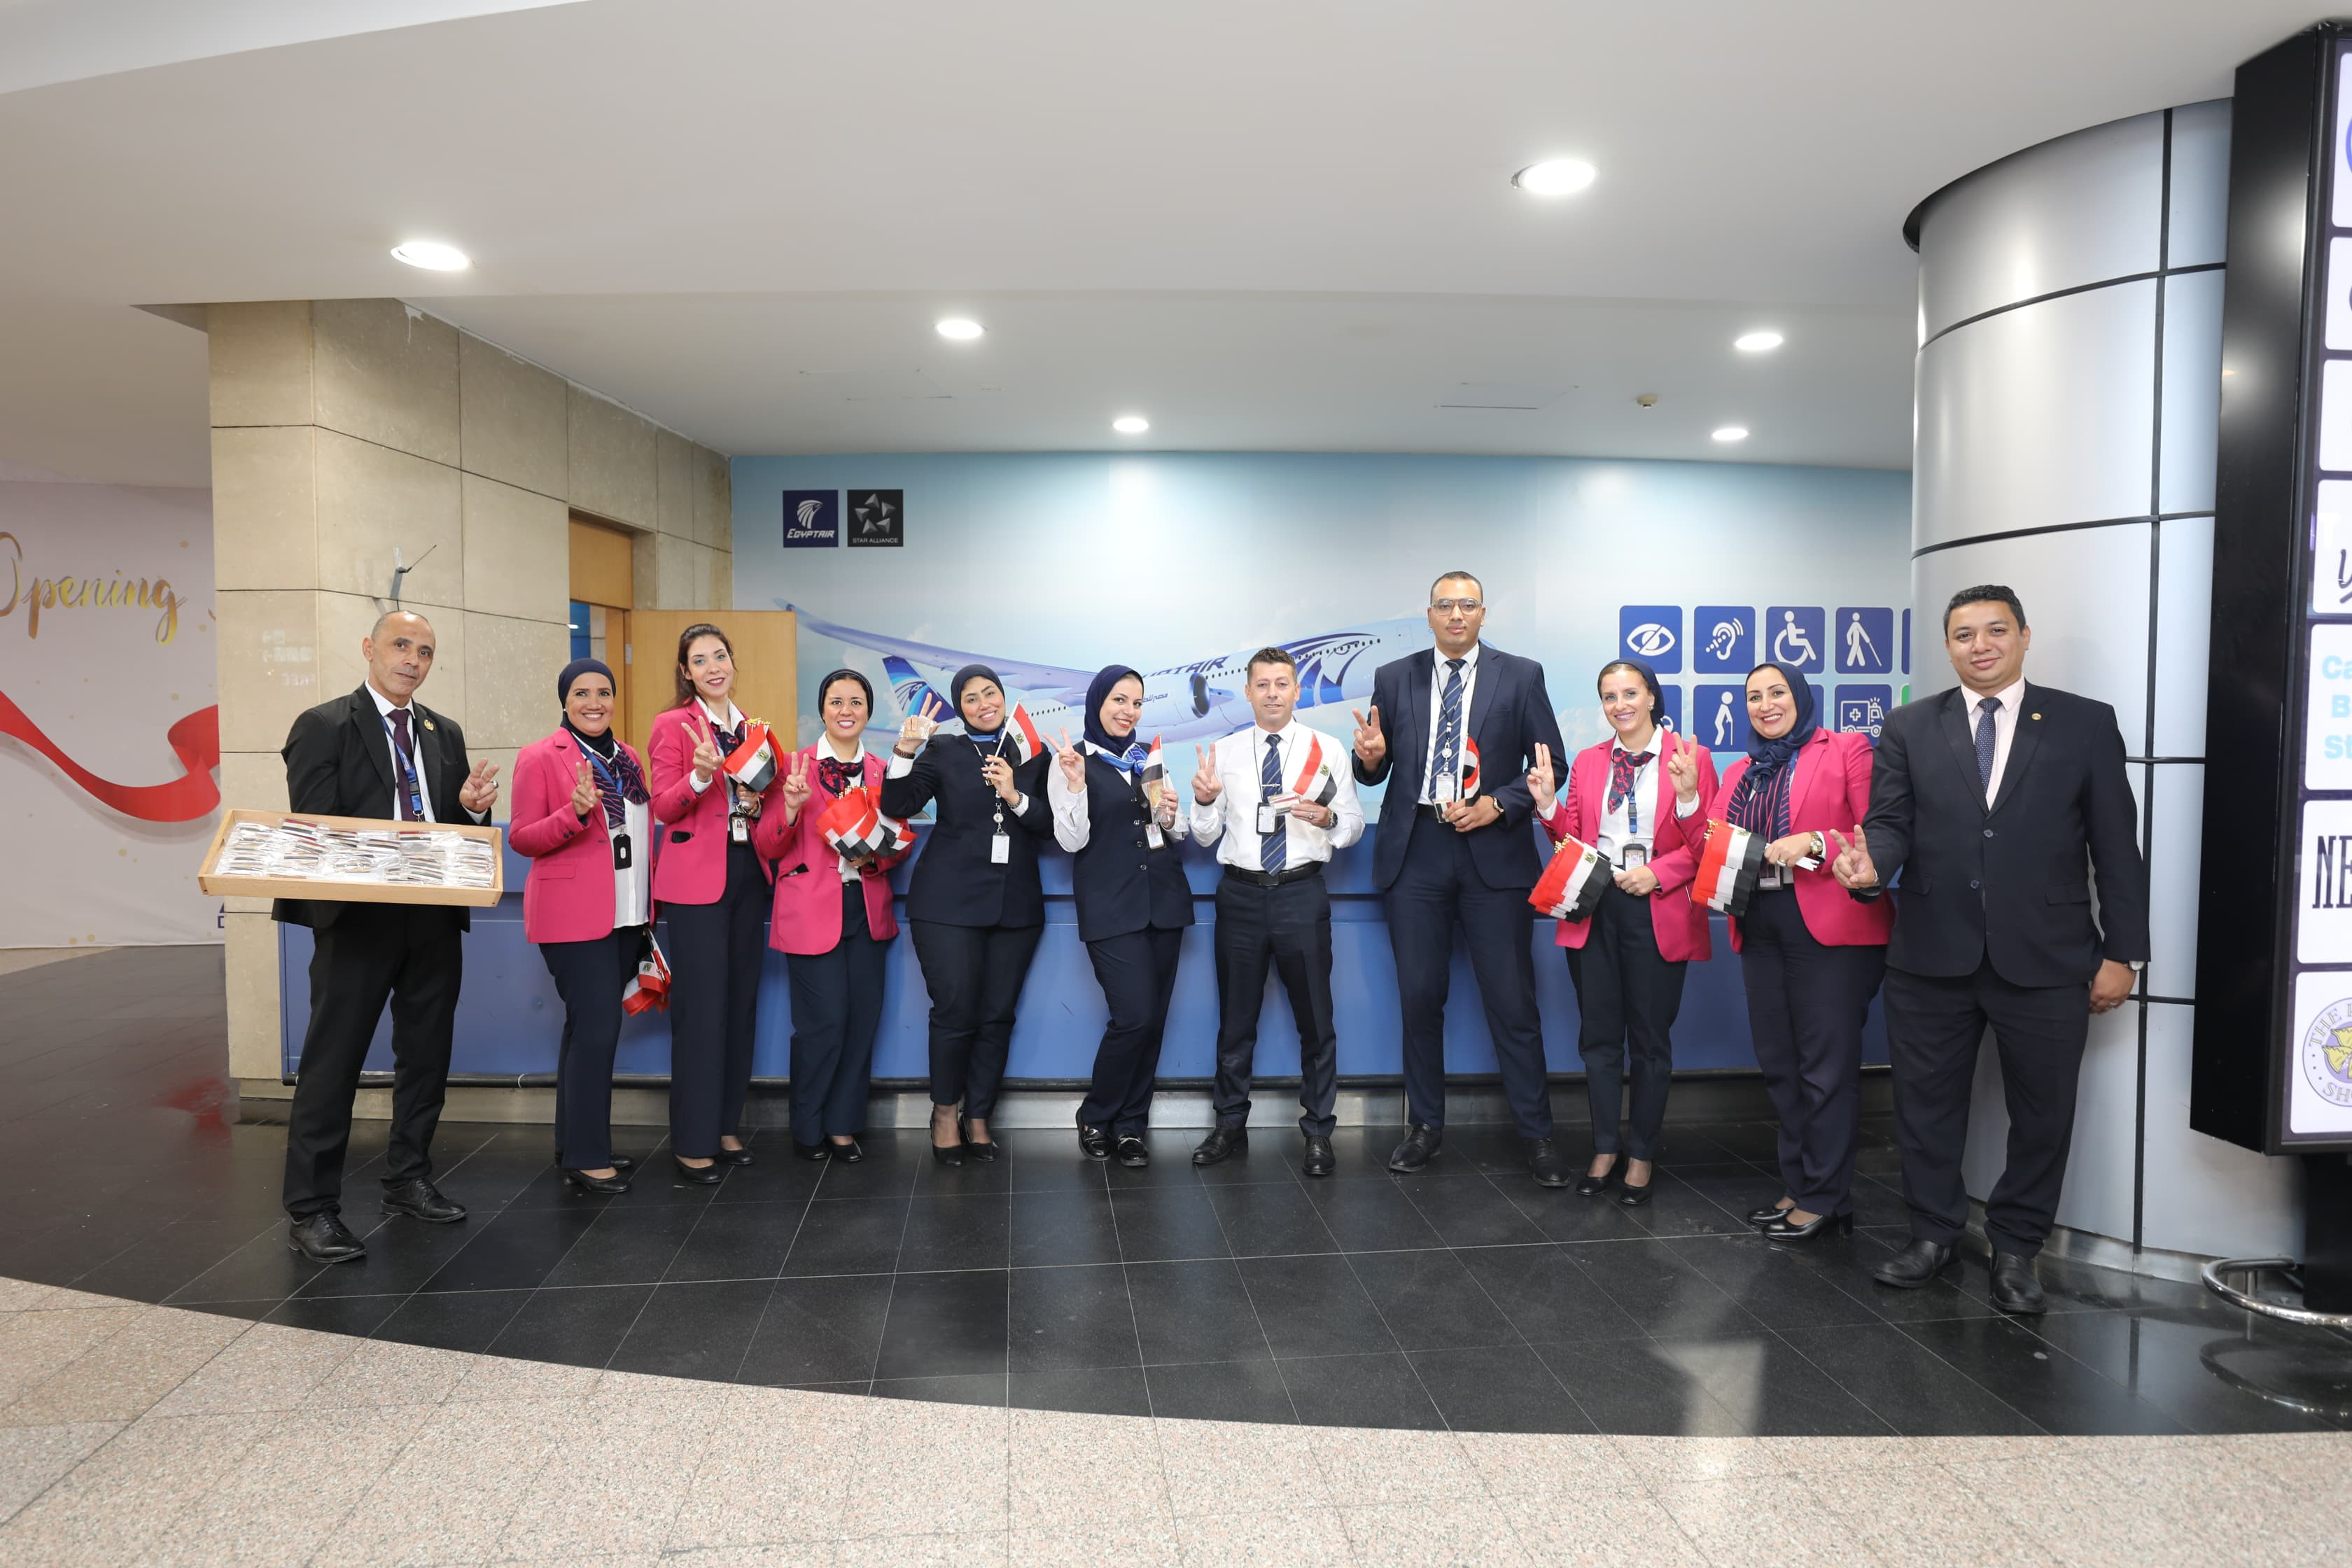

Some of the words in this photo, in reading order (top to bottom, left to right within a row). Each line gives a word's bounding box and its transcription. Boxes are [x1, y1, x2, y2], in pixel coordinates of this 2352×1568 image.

[786, 528, 835, 538] EGYPTAIR
[2309, 1008, 2342, 1047] THE
[2323, 1082, 2352, 1102] SH
